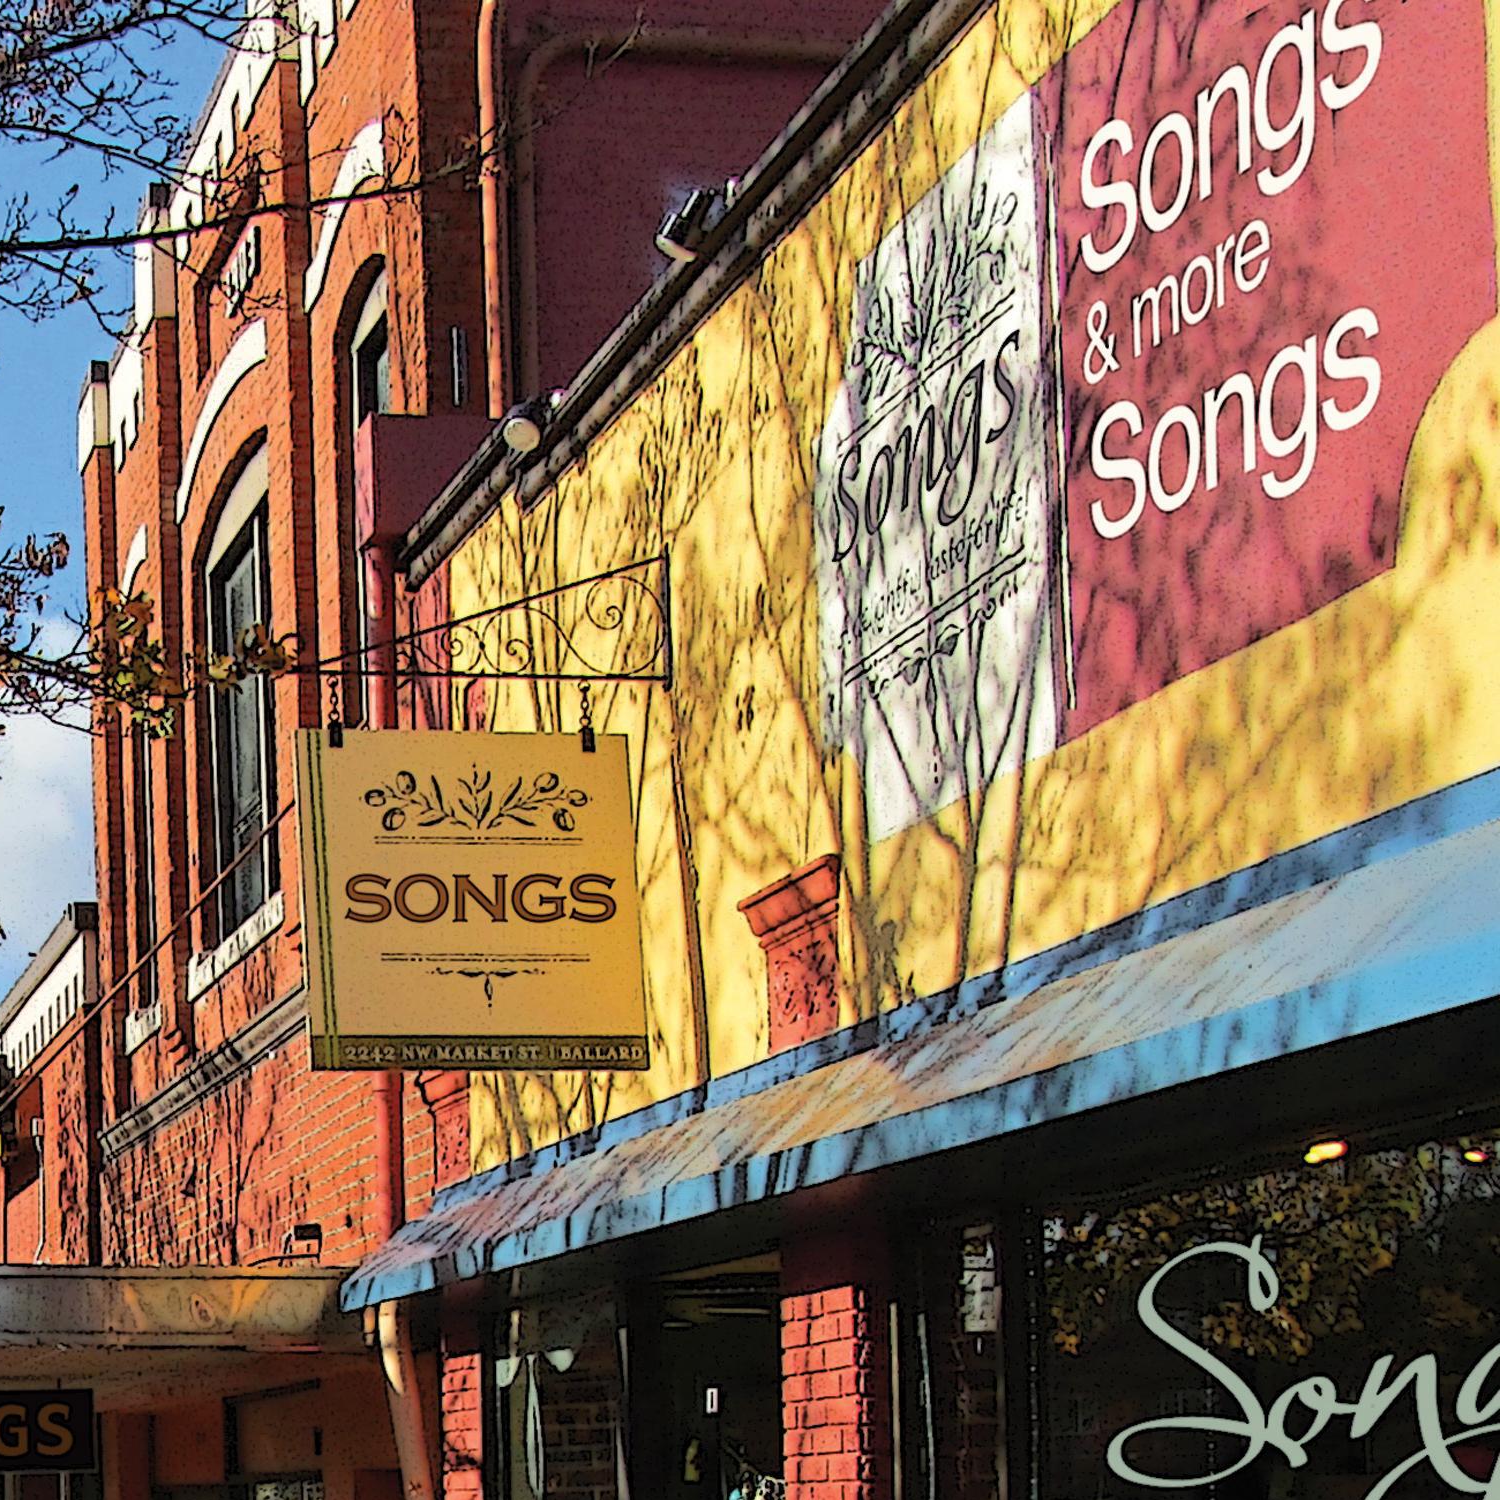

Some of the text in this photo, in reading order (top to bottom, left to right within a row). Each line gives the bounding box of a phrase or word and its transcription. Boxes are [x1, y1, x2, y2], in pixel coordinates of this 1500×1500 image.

[1080, 0, 1383, 274] Songs
[1083, 219, 1271, 385] & more
[1089, 307, 1382, 540] Songs
[345, 873, 617, 923] SONGS
[345, 1046, 396, 1063] 2242
[401, 1046, 432, 1062] NW
[435, 1045, 512, 1062] MARKET
[561, 1045, 645, 1062] BALLARD
